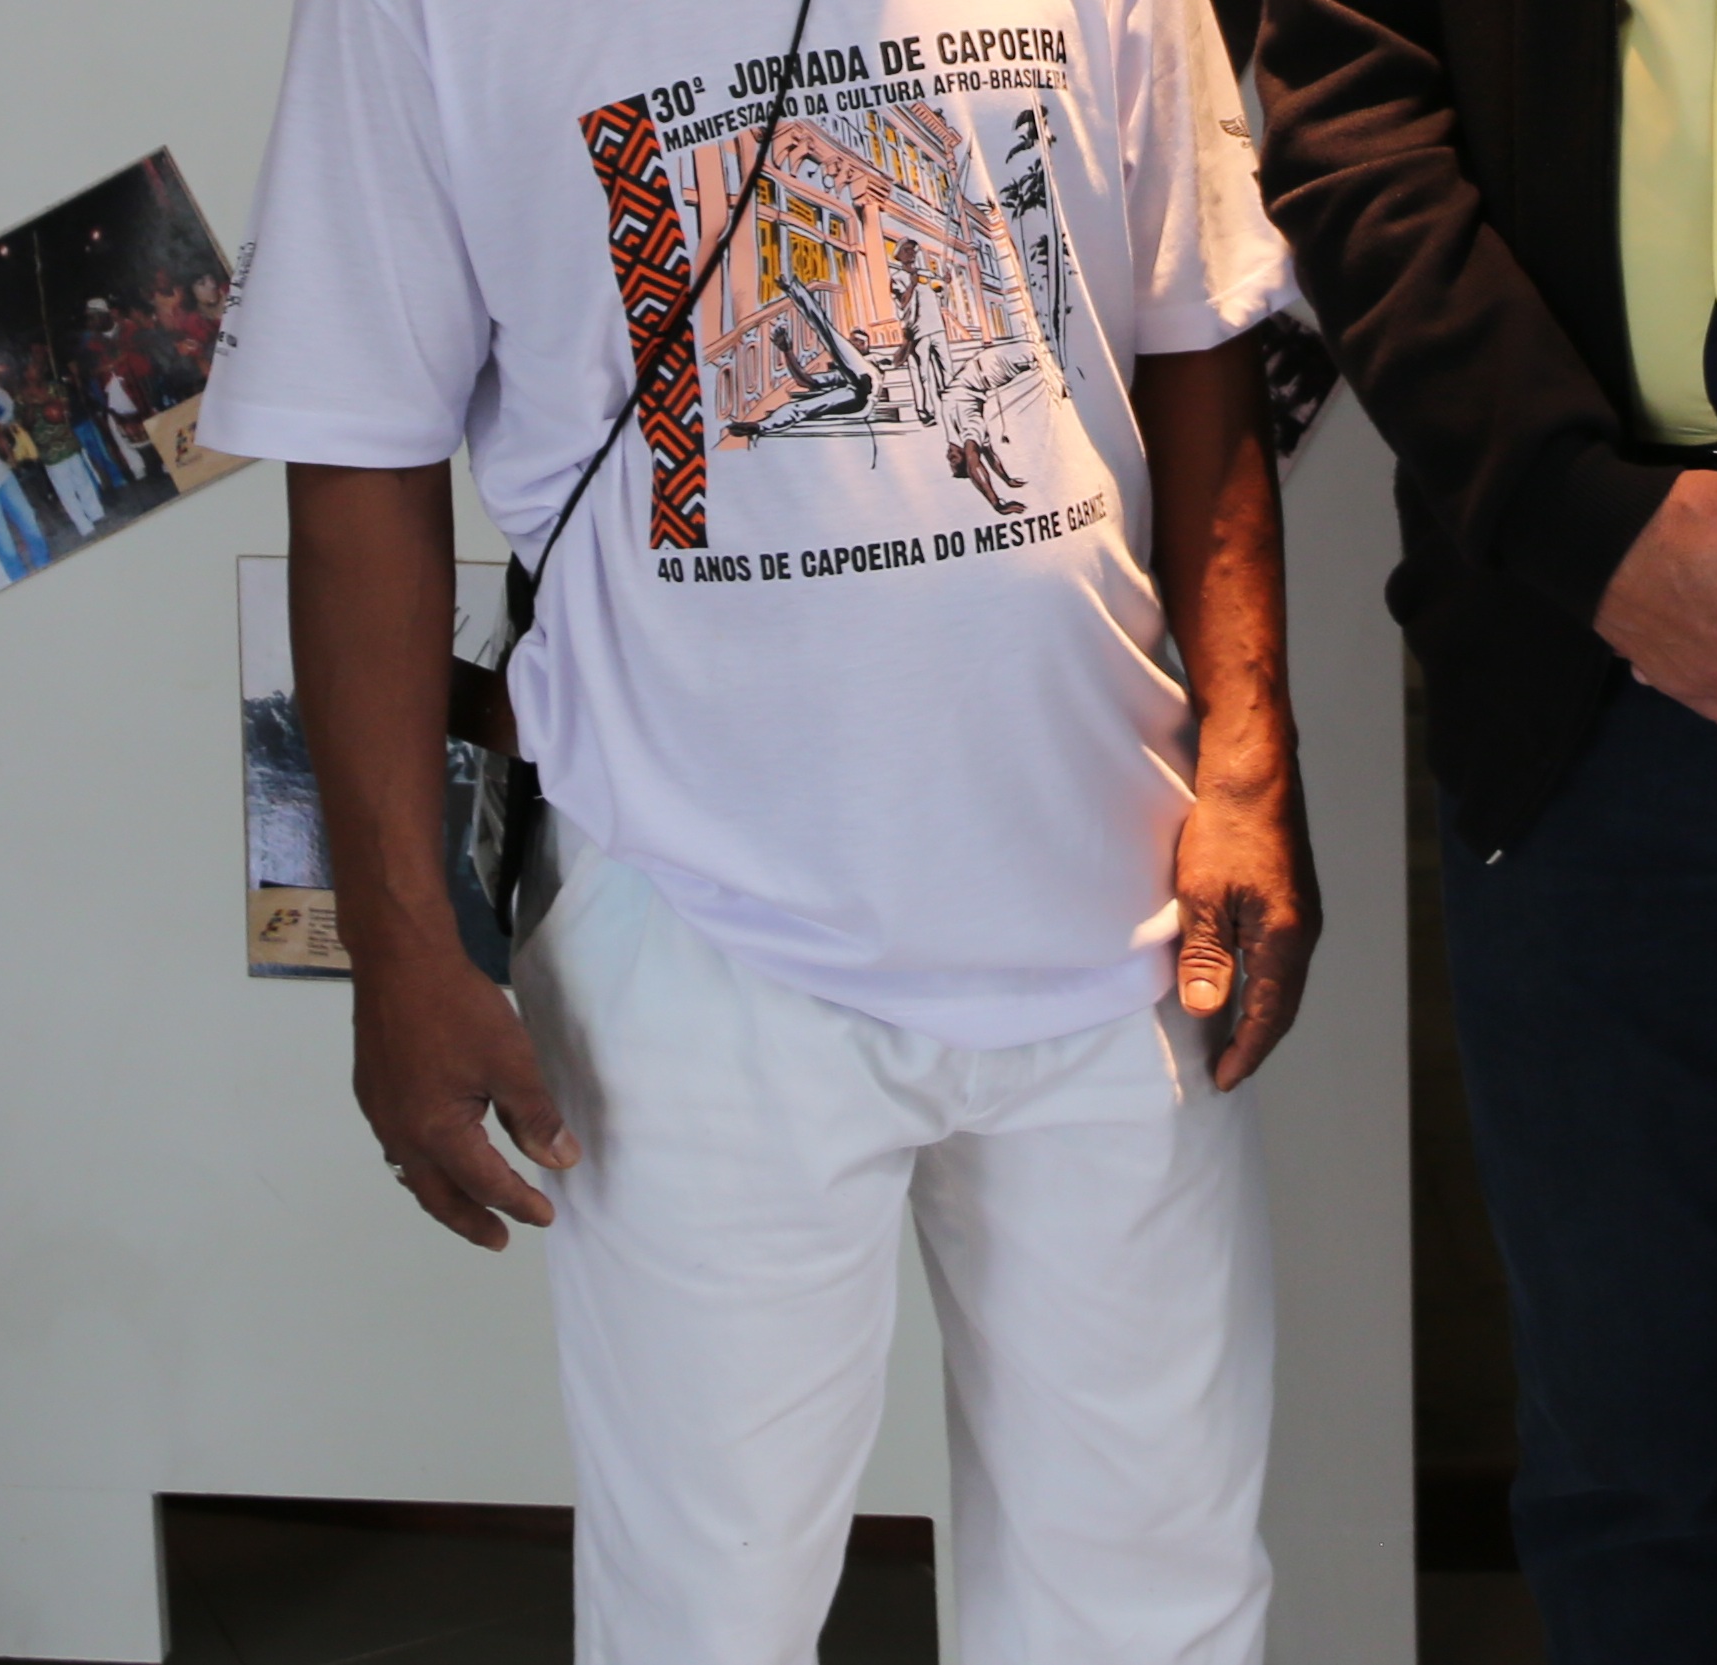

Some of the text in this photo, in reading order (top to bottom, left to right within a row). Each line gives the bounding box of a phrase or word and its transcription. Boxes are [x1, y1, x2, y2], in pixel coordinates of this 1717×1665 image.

[728, 45, 870, 99] JORNADA
[879, 36, 926, 76] DE
[936, 27, 1067, 65] CAPOEIRA
[662, 96, 799, 152] MANIFESTAO
[803, 93, 829, 116] DA
[836, 79, 926, 112] CULTURA
[657, 557, 683, 584] 40
[693, 554, 752, 583] ANOS
[760, 552, 792, 580] DE
[801, 539, 925, 578] CAPOEIRA
[934, 530, 966, 561] DO
[973, 510, 1063, 555] MESTRE
